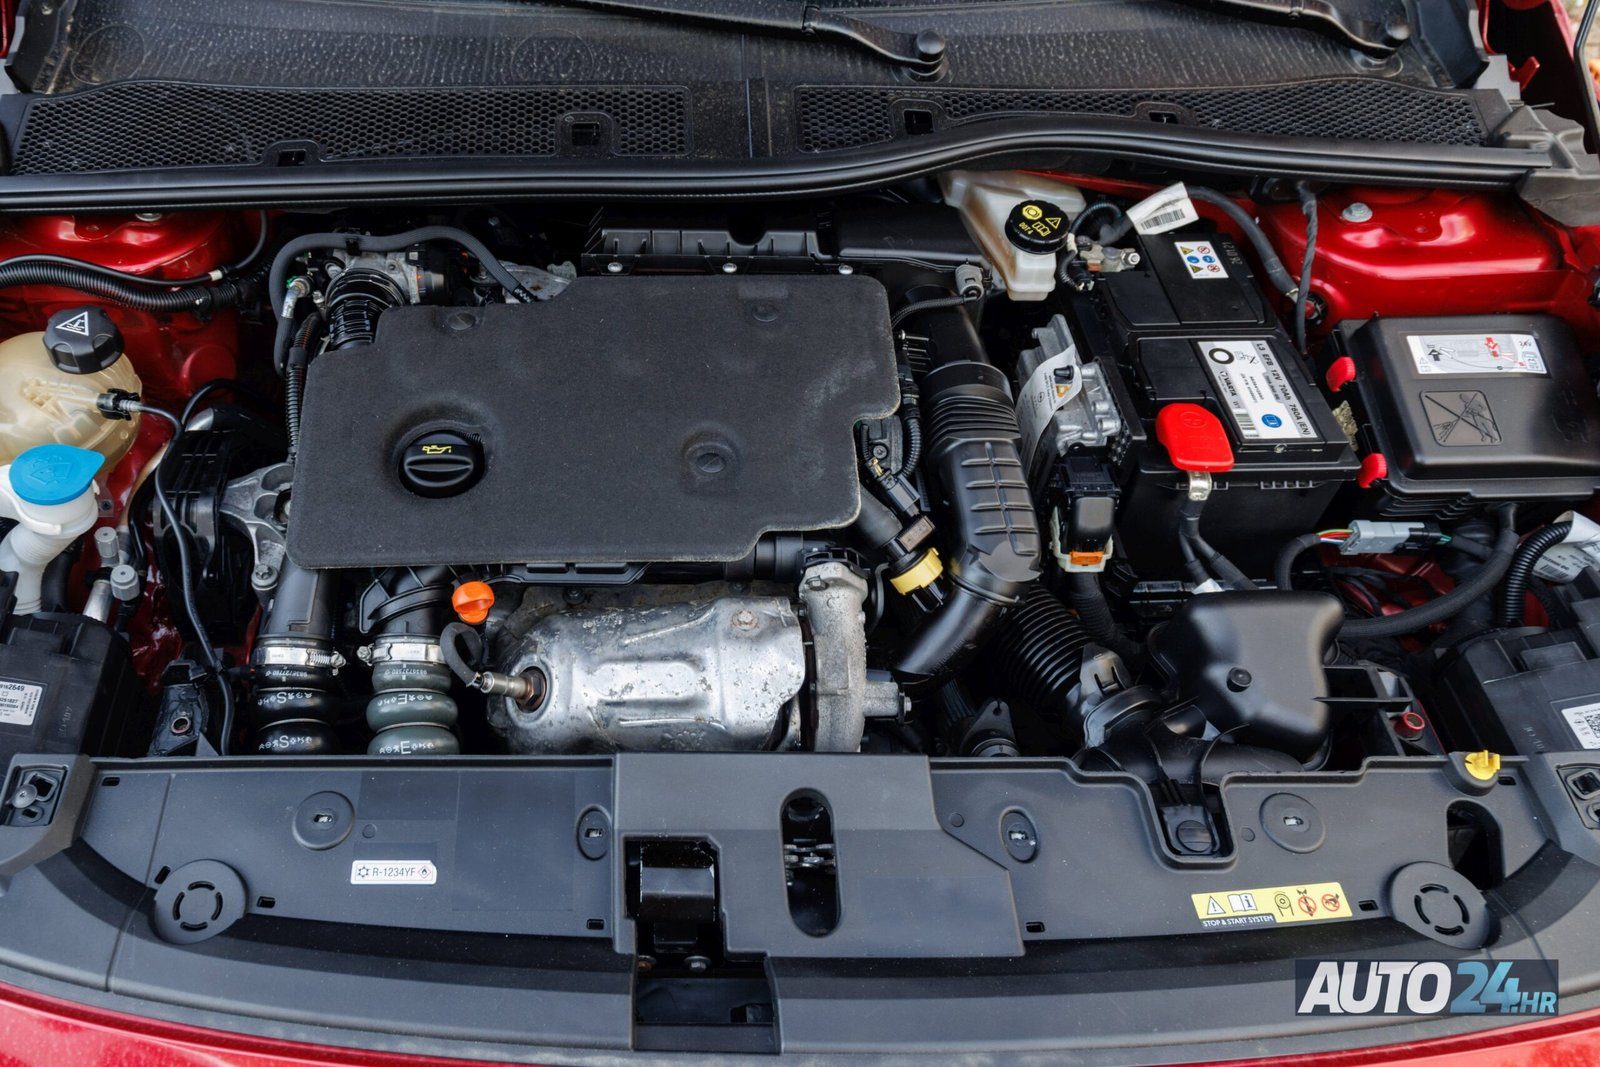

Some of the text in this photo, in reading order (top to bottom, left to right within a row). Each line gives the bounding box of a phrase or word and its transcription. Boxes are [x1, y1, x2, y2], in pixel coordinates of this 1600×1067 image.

[1223, 377, 1238, 397] VARTA
[1256, 342, 1266, 351] L3
[1262, 353, 1274, 366] EFB
[1271, 369, 1283, 381] 12V
[1279, 384, 1291, 401] 70Ah
[1289, 403, 1303, 421] 760A
[1297, 420, 1311, 436] (EN)
[372, 867, 416, 877] R-1234YF
[1227, 917, 1247, 925] START
[1248, 915, 1273, 923] SYSTEM
